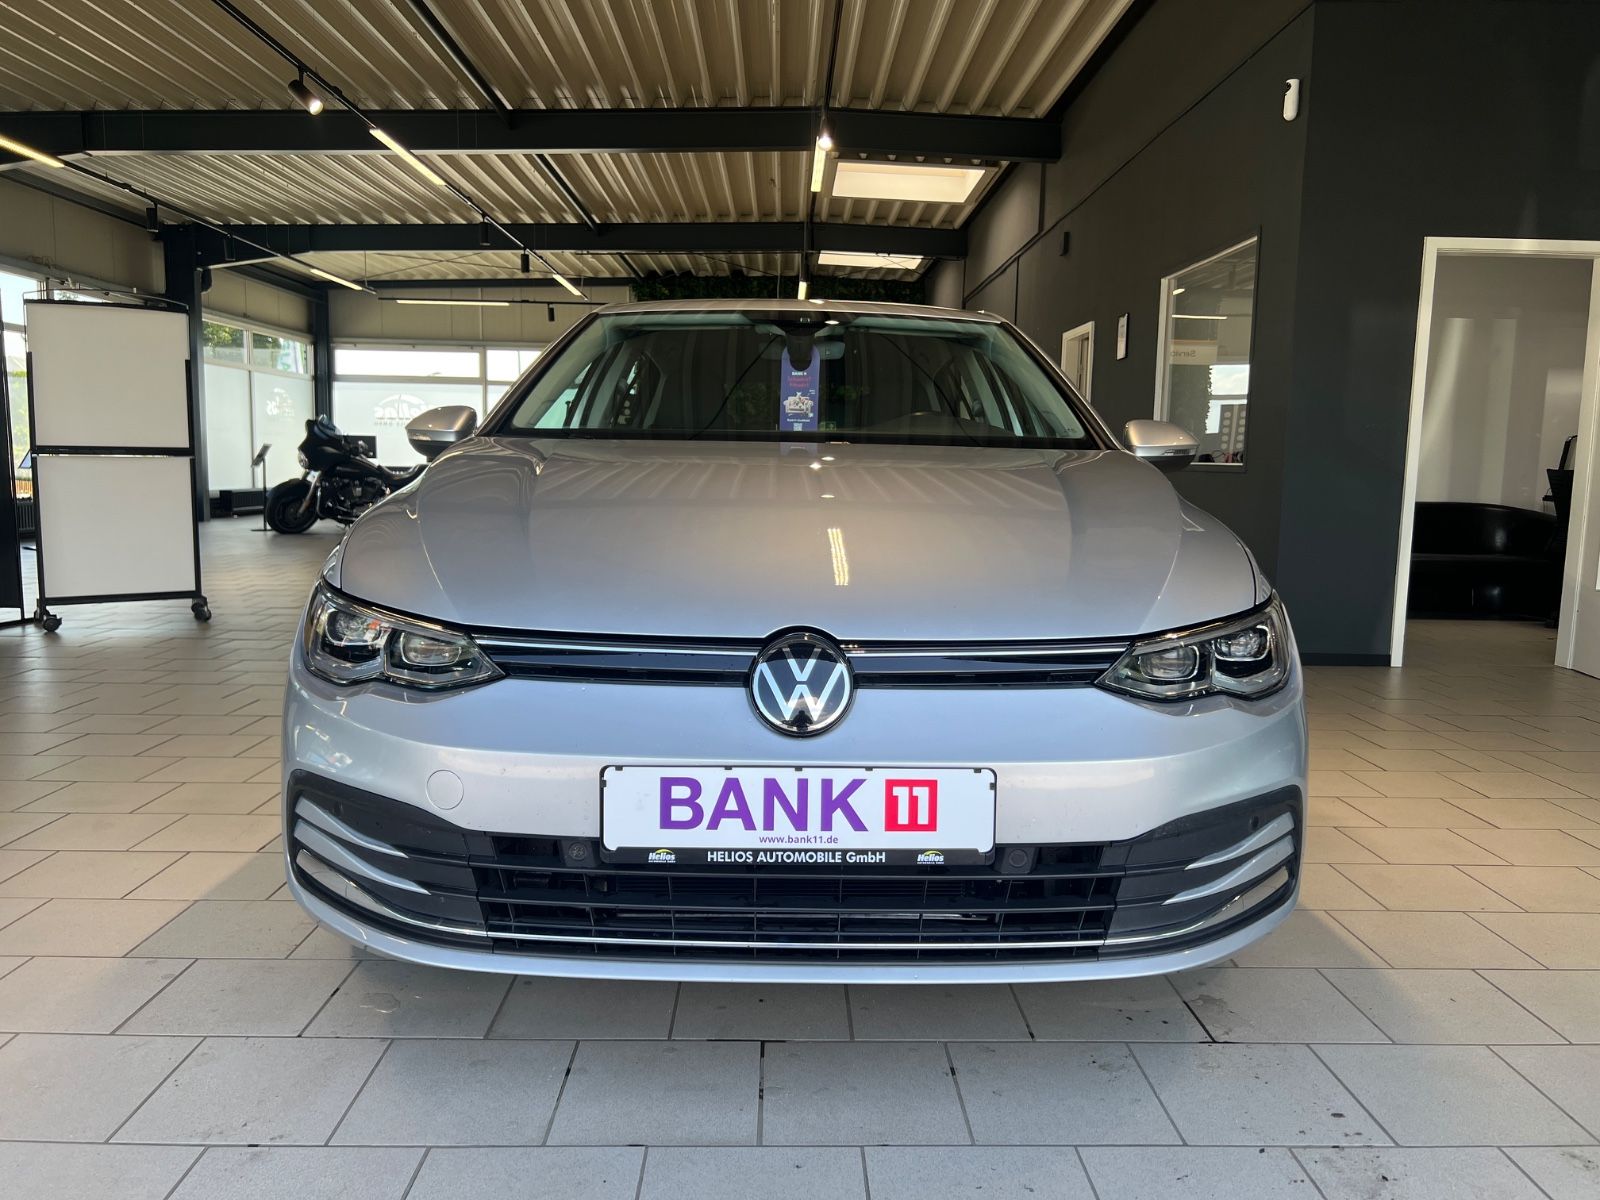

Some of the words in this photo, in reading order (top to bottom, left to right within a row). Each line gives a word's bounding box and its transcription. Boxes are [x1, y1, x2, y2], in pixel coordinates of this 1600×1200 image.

[659, 777, 869, 832] BANK
[890, 785, 931, 826] 11
[759, 835, 839, 844] www.bank11.de
[648, 852, 676, 861] Helios
[707, 851, 753, 863] HELIOS
[757, 851, 842, 863] AUTOMOBILE
[846, 851, 886, 863] GmbH
[917, 853, 944, 862] Helios
